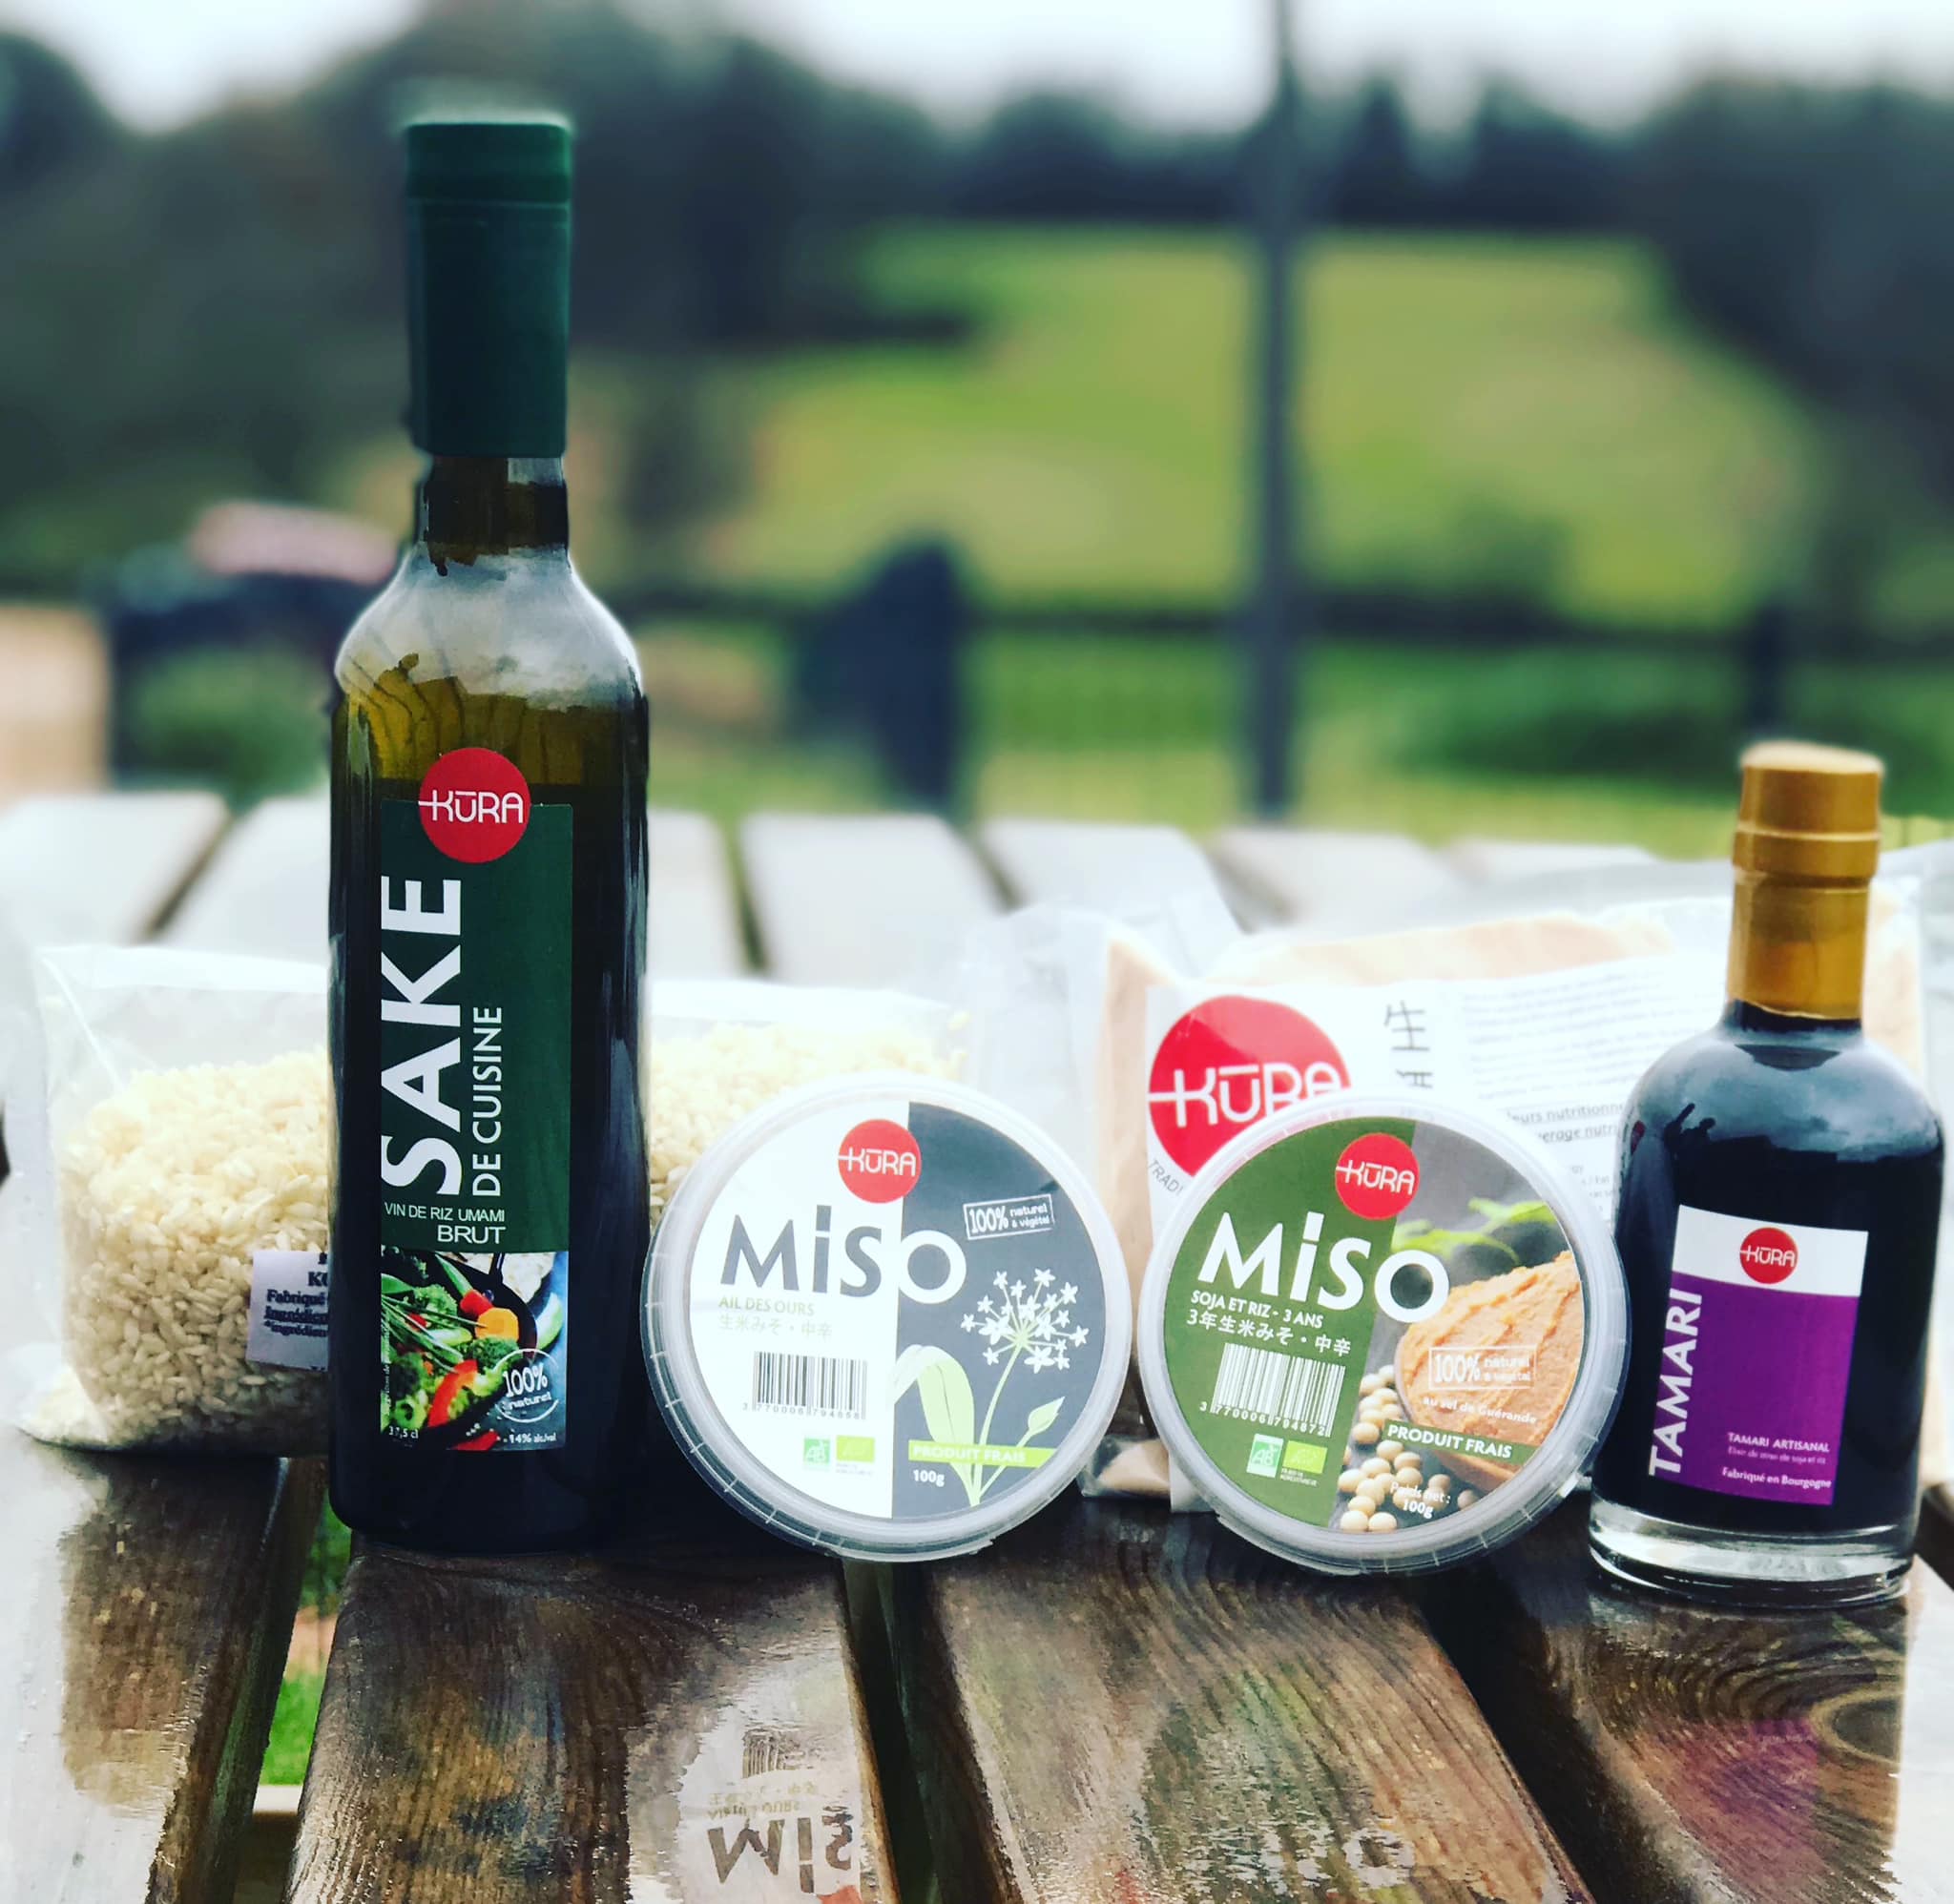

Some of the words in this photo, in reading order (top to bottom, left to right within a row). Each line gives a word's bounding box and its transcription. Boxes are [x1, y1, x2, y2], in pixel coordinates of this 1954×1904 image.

[382, 876, 462, 1196] SAKE
[472, 1006, 502, 1144] CUISINE
[472, 1153, 502, 1196] DE
[384, 1202, 405, 1217] VIN
[408, 1205, 426, 1218] DE
[430, 1207, 453, 1221] RIZ
[458, 1209, 505, 1222] UMAMI
[968, 1205, 1009, 1233] 100%
[437, 1225, 506, 1244] BRUT
[745, 1297, 772, 1313] DES
[774, 1299, 815, 1317] OURS
[1191, 1290, 1226, 1310] SOJA
[1229, 1297, 1247, 1314] ET
[1248, 1302, 1272, 1318] RIZ
[1283, 1309, 1292, 1323] 3
[1293, 1311, 1324, 1330] ANS
[503, 1362, 549, 1397] 100%
[1434, 1354, 1482, 1383] 100%
[1649, 1288, 1702, 1476] TAMARI
[913, 1445, 981, 1460] PRODUIT
[984, 1449, 1026, 1462] FRAIS
[1387, 1424, 1464, 1450] PRODUIT
[1465, 1438, 1512, 1459] FRAIS
[1728, 1432, 1770, 1447] TAMARI
[1773, 1438, 1830, 1454] ARTISANAL
[913, 1469, 945, 1487] 100g
[1722, 1466, 1765, 1484] Fabriqué
[1766, 1475, 1779, 1484] en
[1781, 1474, 1832, 1490] Bourgogne
[1403, 1499, 1434, 1520] 100g
